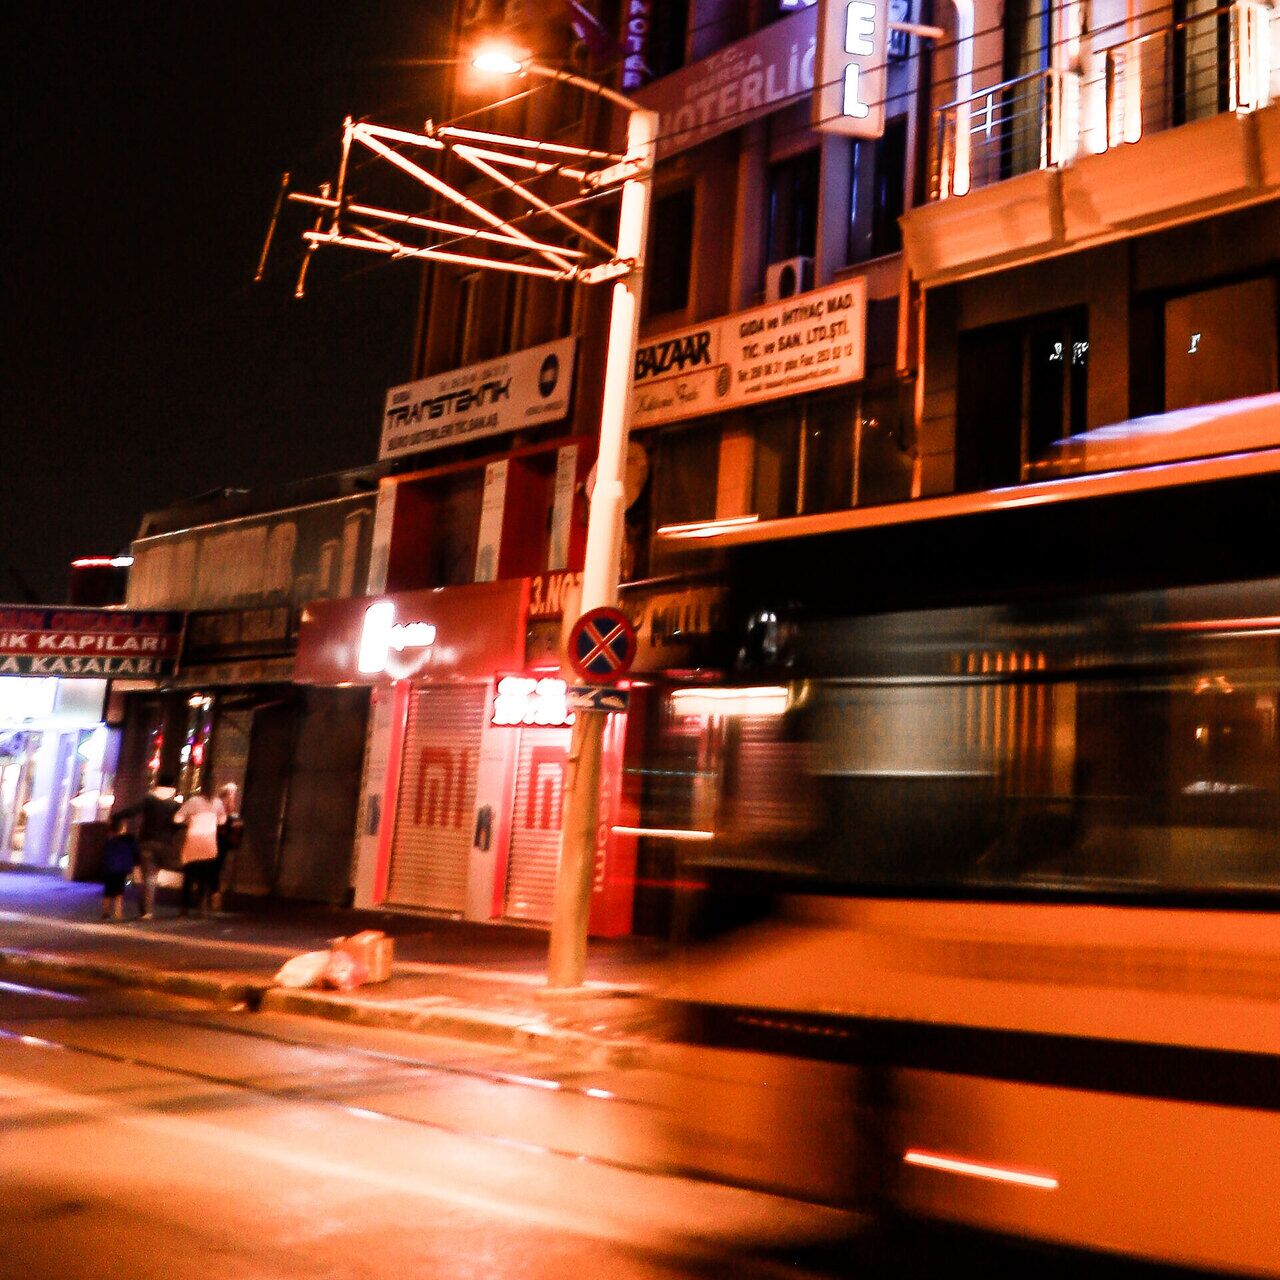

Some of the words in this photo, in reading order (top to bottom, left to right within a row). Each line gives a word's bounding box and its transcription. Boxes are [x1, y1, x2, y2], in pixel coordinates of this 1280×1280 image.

[634, 330, 711, 381] BAZAAR
[37, 634, 167, 651] KAPILARI
[30, 656, 162, 674] KASALARI
